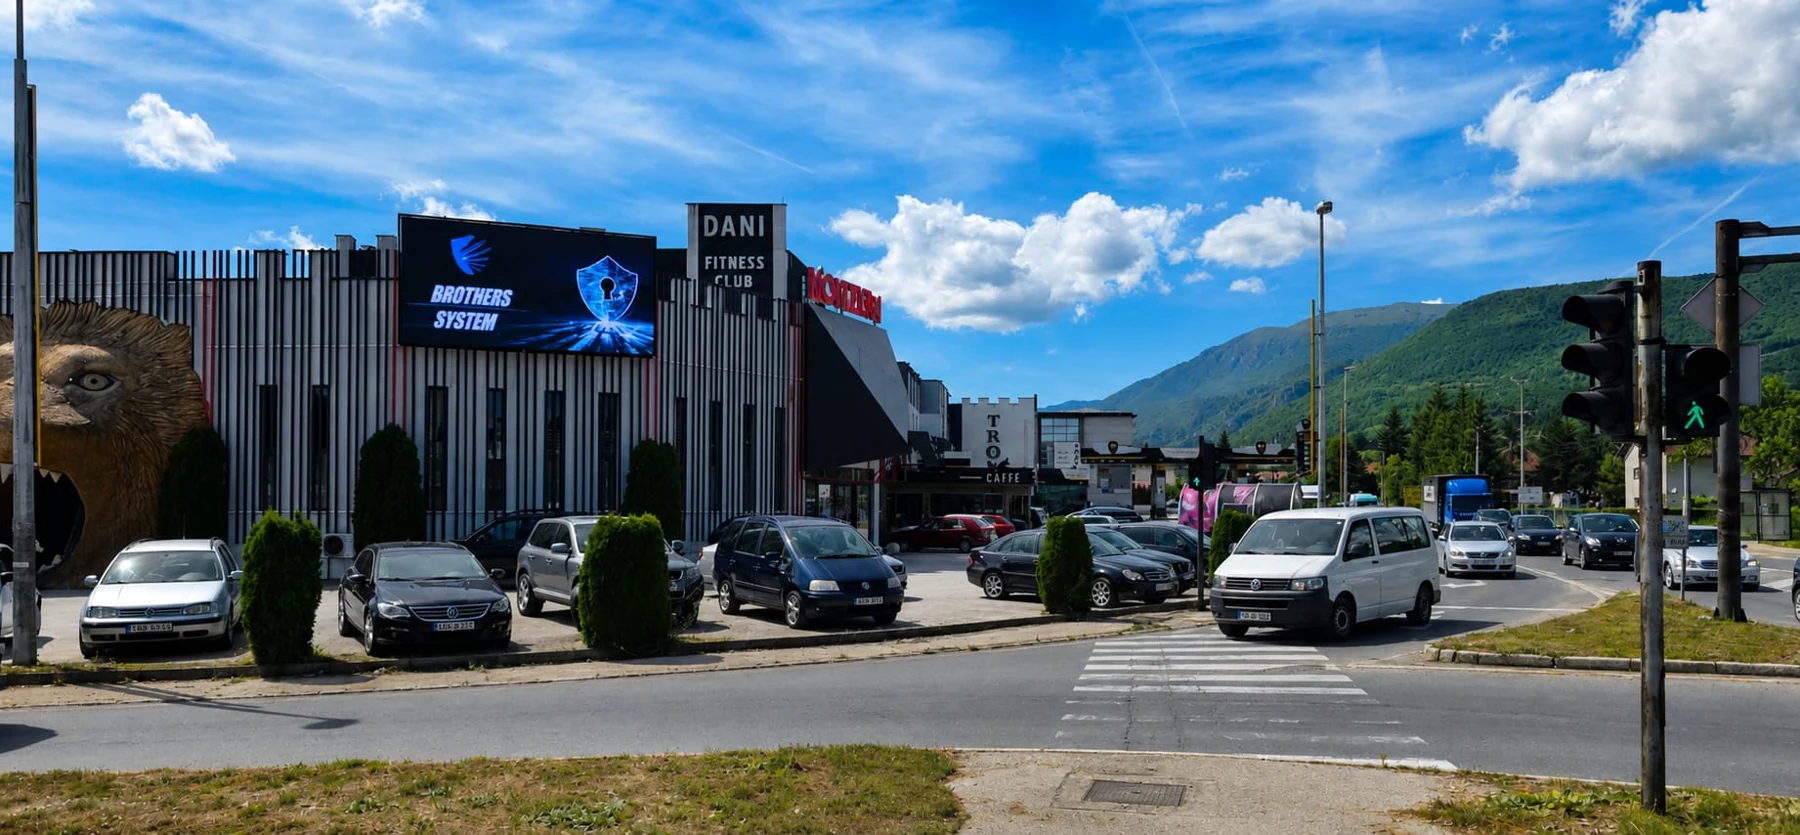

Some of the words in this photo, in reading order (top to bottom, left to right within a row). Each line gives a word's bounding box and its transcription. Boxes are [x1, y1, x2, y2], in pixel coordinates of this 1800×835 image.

[703, 214, 765, 237] DANI
[705, 255, 765, 270] FITNESS
[714, 274, 753, 288] CLUB
[430, 284, 514, 307] BROTHERS
[433, 310, 499, 331] SYSTEM
[986, 472, 1020, 484] CAFFE
